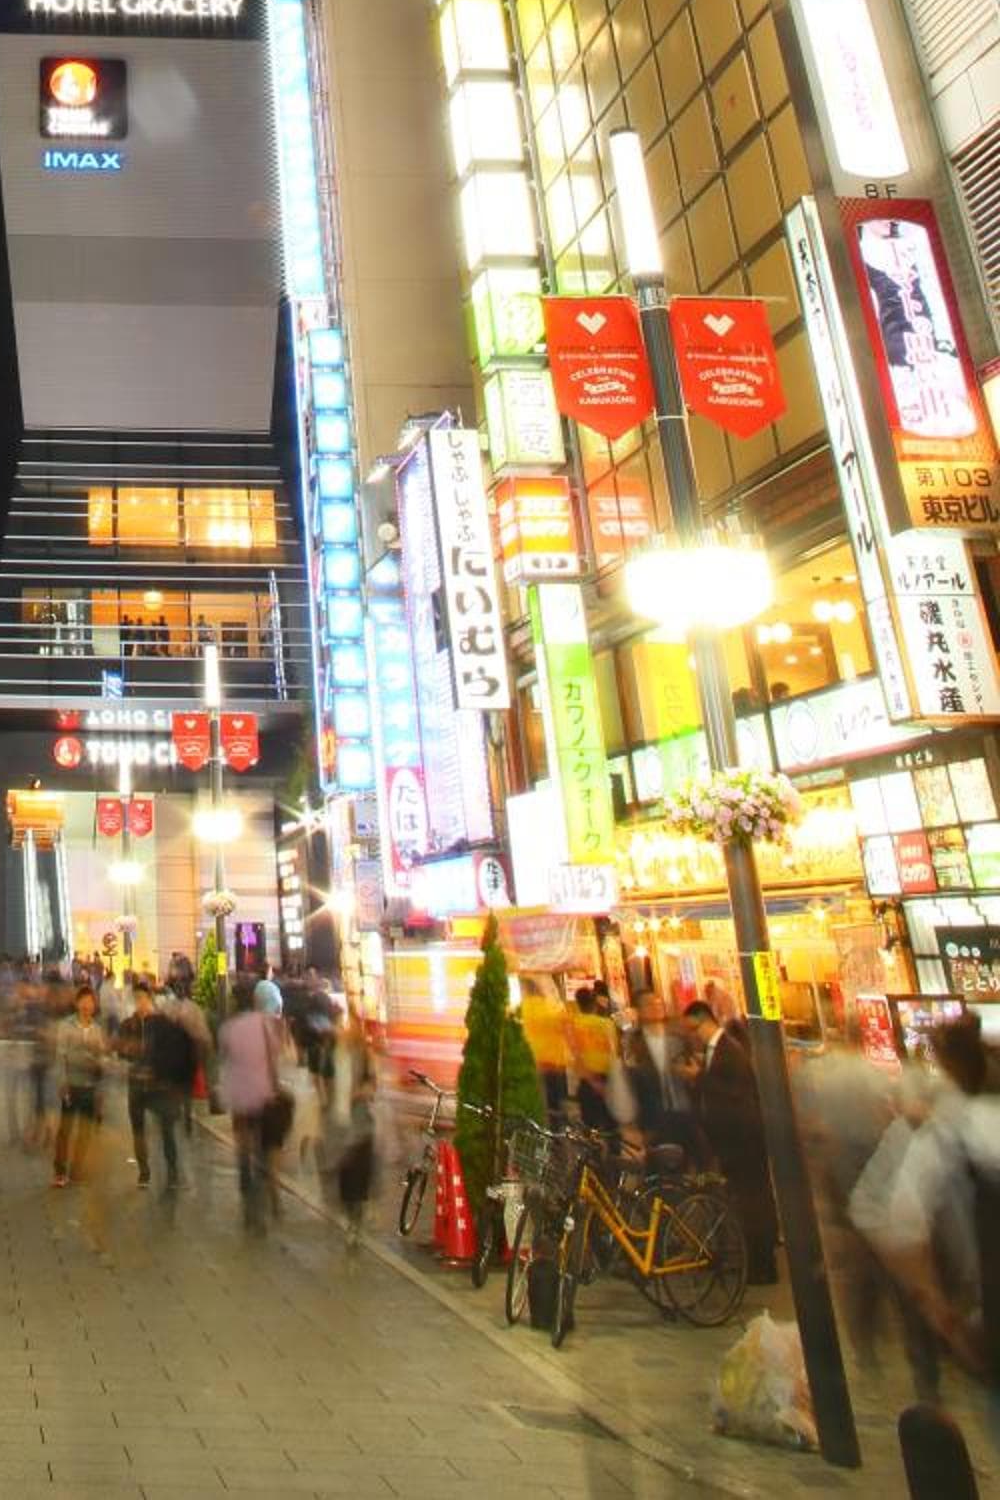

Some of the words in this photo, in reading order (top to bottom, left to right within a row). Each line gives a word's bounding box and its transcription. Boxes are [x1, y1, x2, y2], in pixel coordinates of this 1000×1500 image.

[44, 152, 121, 169] IMAX
[920, 492, 1000, 525] 東京ビル
[896, 571, 966, 592] ルノアール
[452, 546, 500, 698] にいむら
